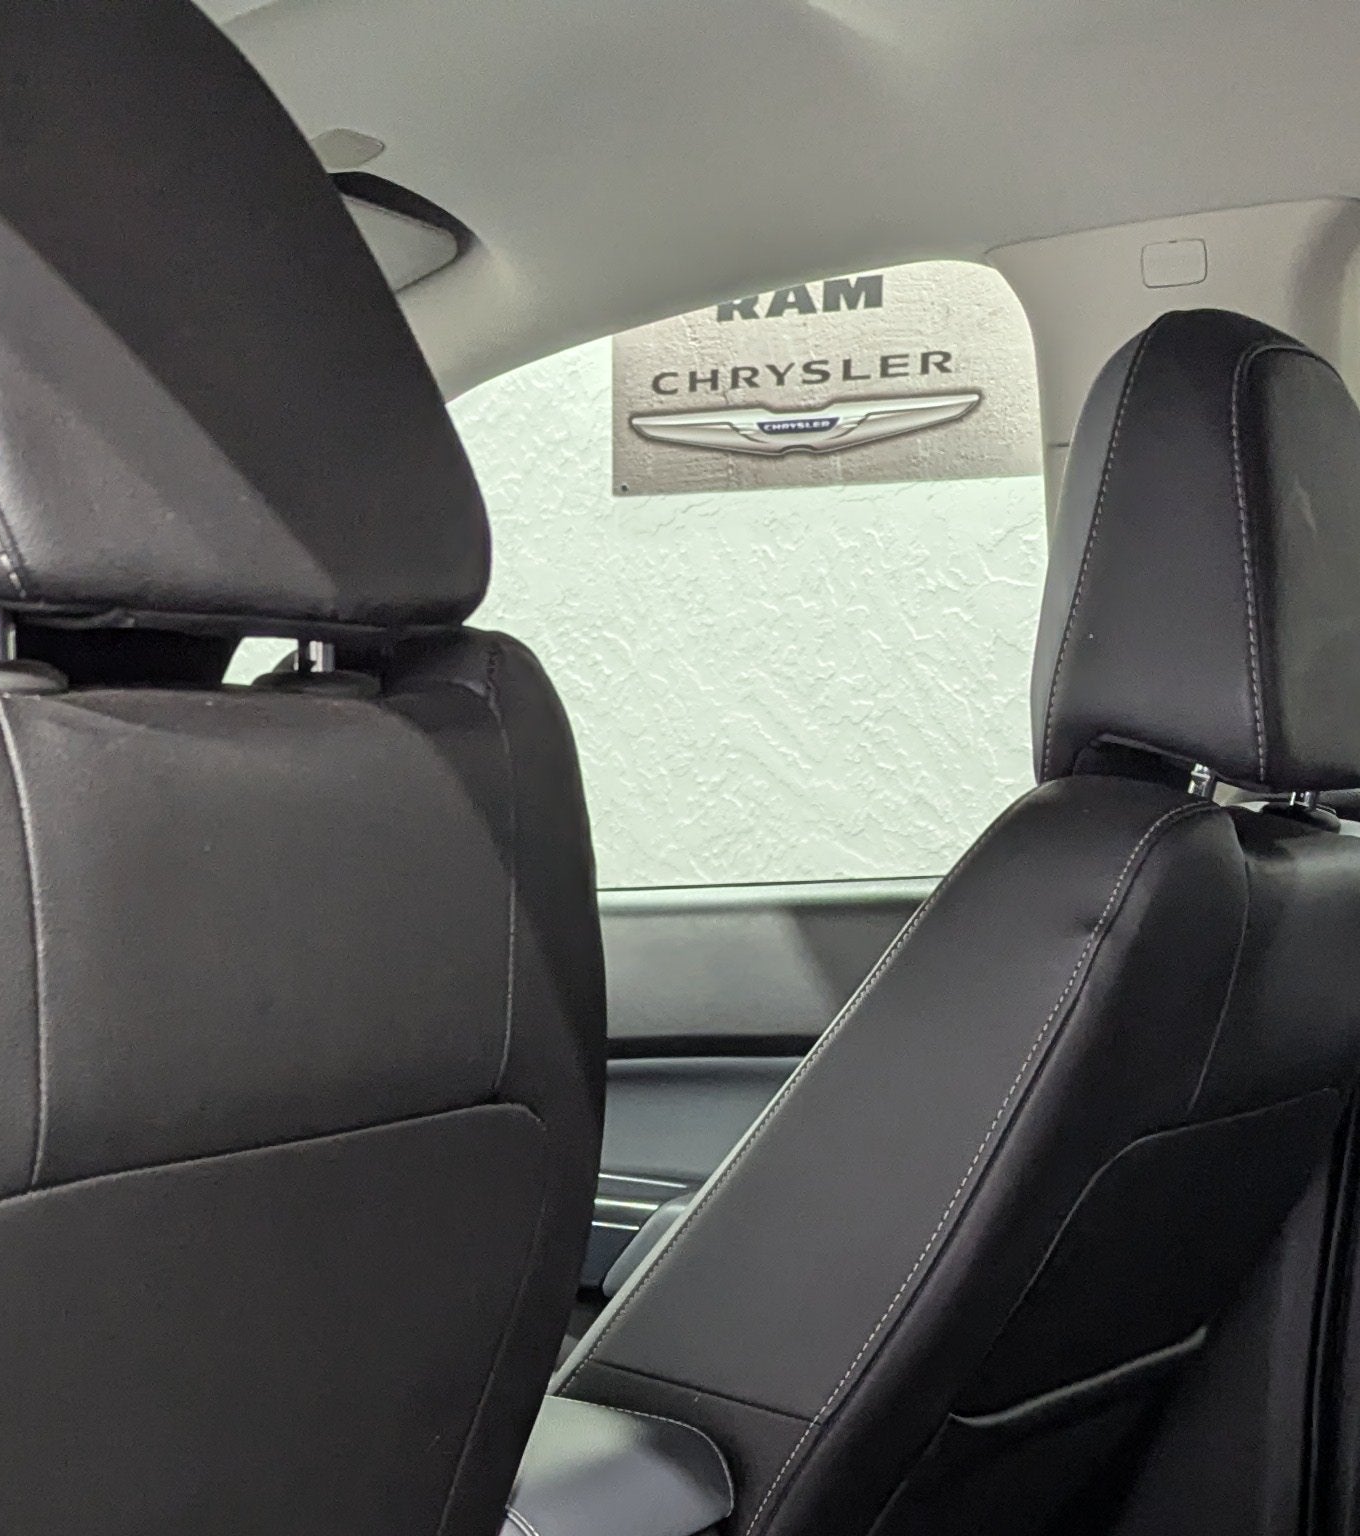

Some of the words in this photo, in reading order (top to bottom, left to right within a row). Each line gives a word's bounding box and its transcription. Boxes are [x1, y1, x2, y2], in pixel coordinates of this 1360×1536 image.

[716, 275, 884, 322] RAM
[651, 350, 954, 396] CHRYSLER
[763, 420, 831, 432] CHRYSLER
